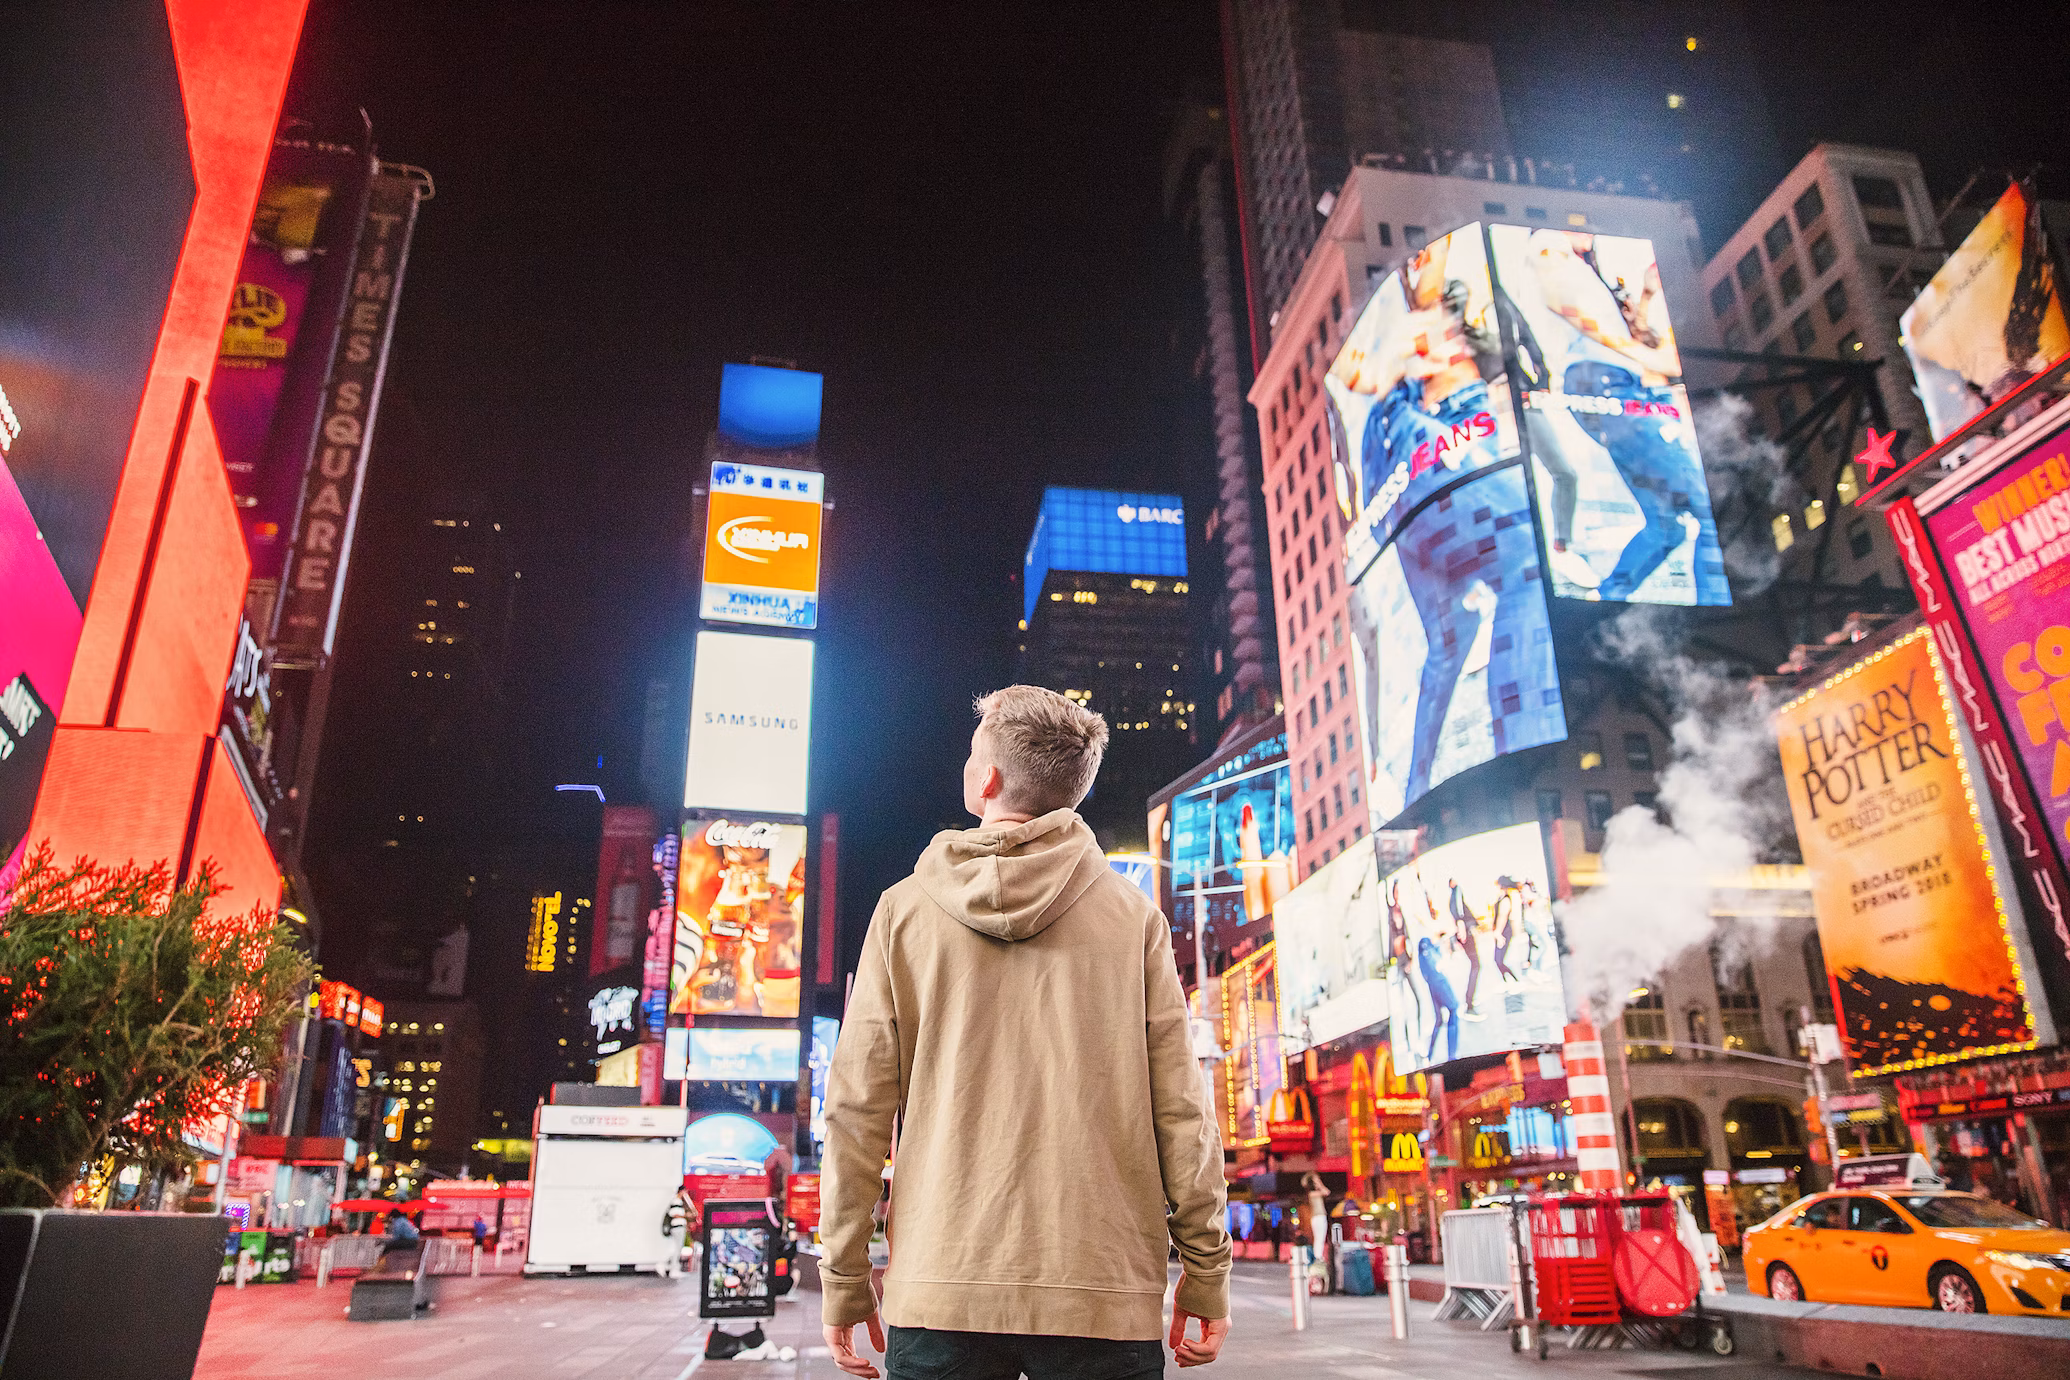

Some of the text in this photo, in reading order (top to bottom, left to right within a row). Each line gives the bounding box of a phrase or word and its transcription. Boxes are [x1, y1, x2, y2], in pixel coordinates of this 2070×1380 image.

[296, 211, 401, 590] TIMES SQUARE
[1410, 411, 1496, 480] JEANS
[1955, 526, 2016, 588] BEST
[728, 592, 790, 610] XINHUA
[704, 711, 799, 731] SAMSUNG
[1800, 669, 1918, 770] HARRY
[1802, 722, 1949, 820] POTTER
[1851, 853, 1942, 896] BROADWAY
[1852, 884, 1911, 915] SPRING
[537, 891, 562, 972] NOVOTEL
